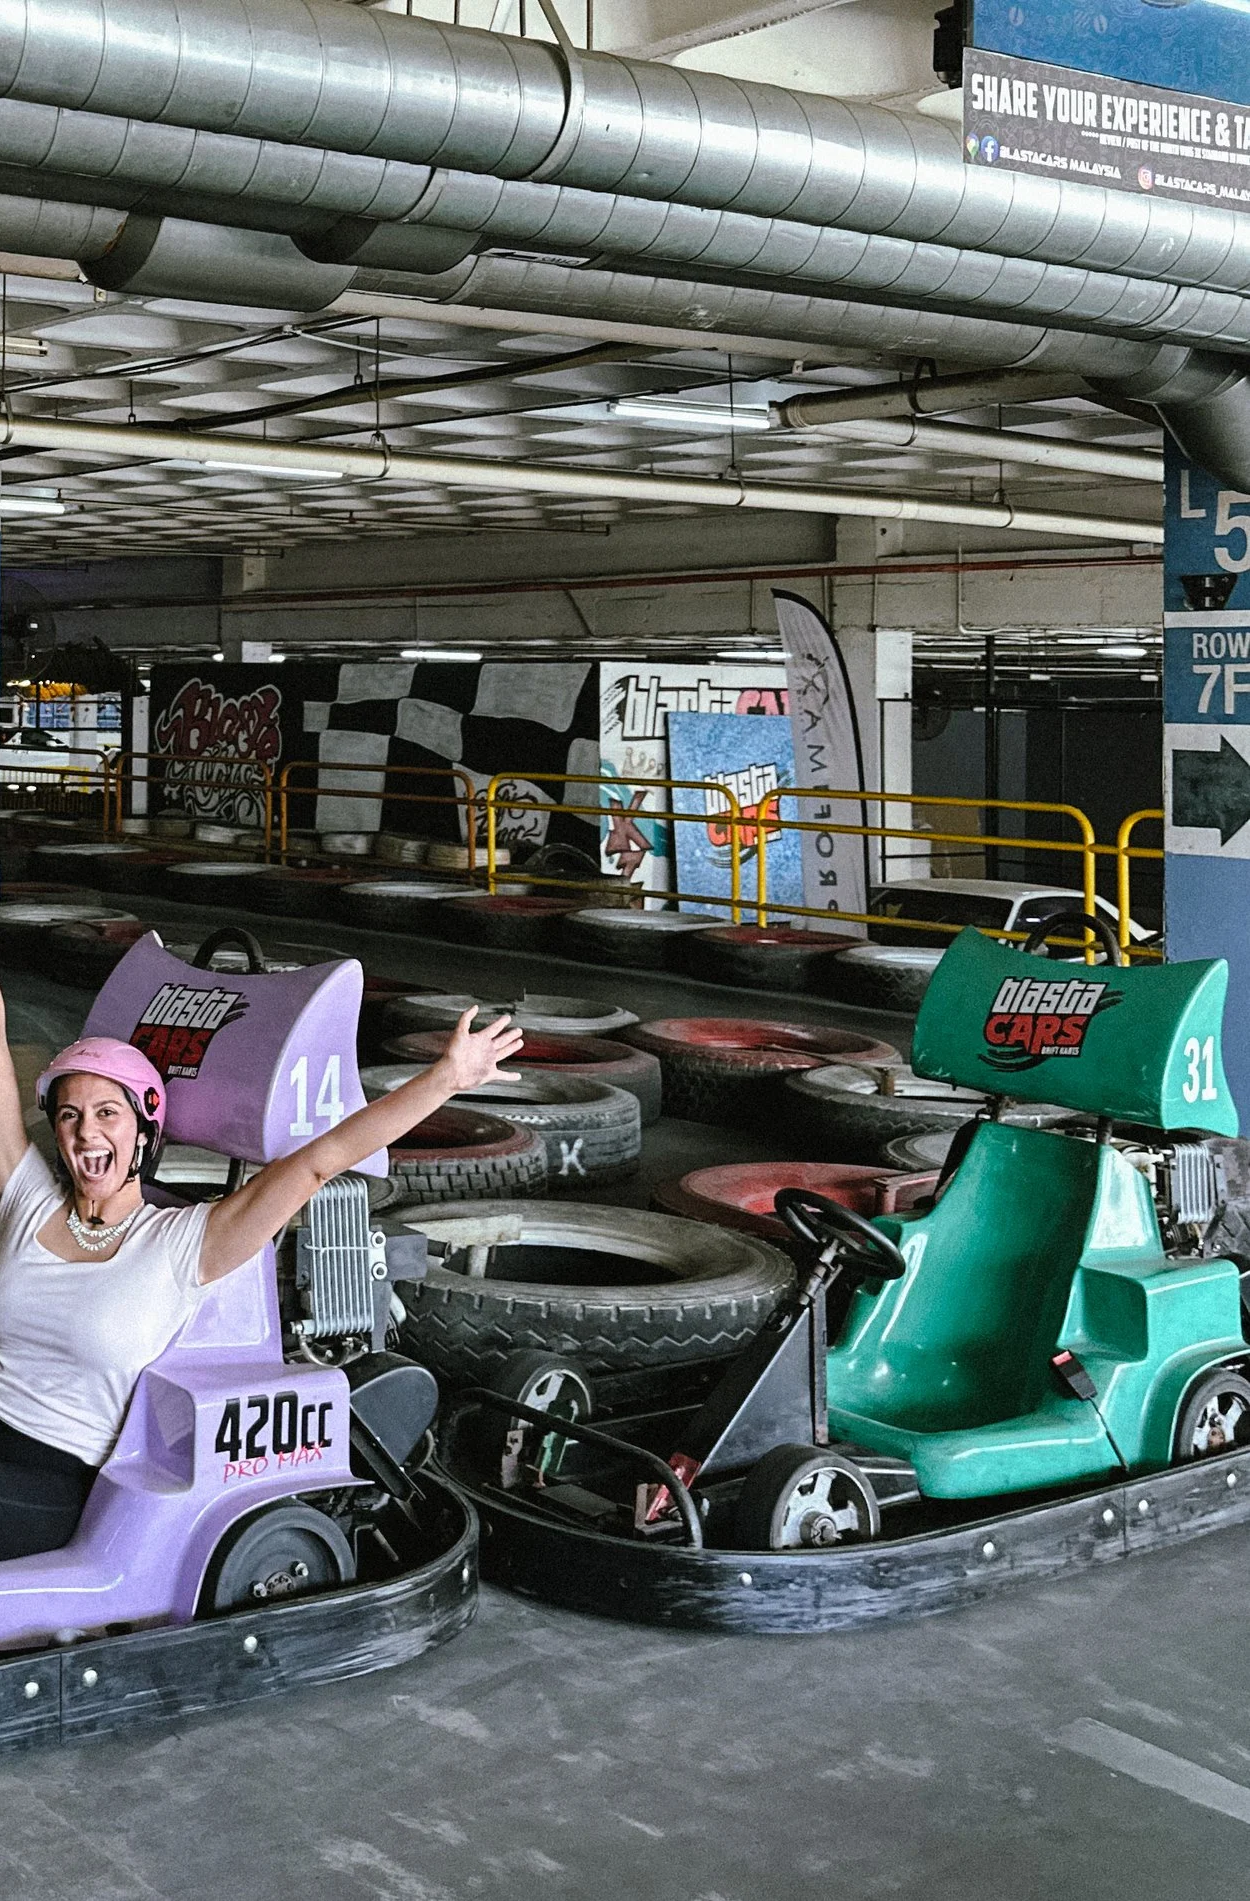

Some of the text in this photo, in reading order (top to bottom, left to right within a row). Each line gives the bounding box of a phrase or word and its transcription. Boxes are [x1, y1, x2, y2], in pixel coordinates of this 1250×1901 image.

[971, 73, 1039, 119] SHARE
[1042, 84, 1097, 128] YOUR
[1101, 95, 1211, 144] EXPERIENCE
[1214, 112, 1230, 148] &
[1069, 158, 1122, 179] MALAYSIA
[1191, 631, 1250, 660] ROW
[139, 983, 241, 1030] blasta
[990, 977, 1107, 1015] blasta
[985, 1014, 1088, 1055] CARS
[1182, 1035, 1218, 1104] 31
[289, 1054, 345, 1137] 14
[558, 1137, 586, 1176] K
[214, 1390, 334, 1463] 420cc
[223, 1442, 324, 1484] PRO MAX
